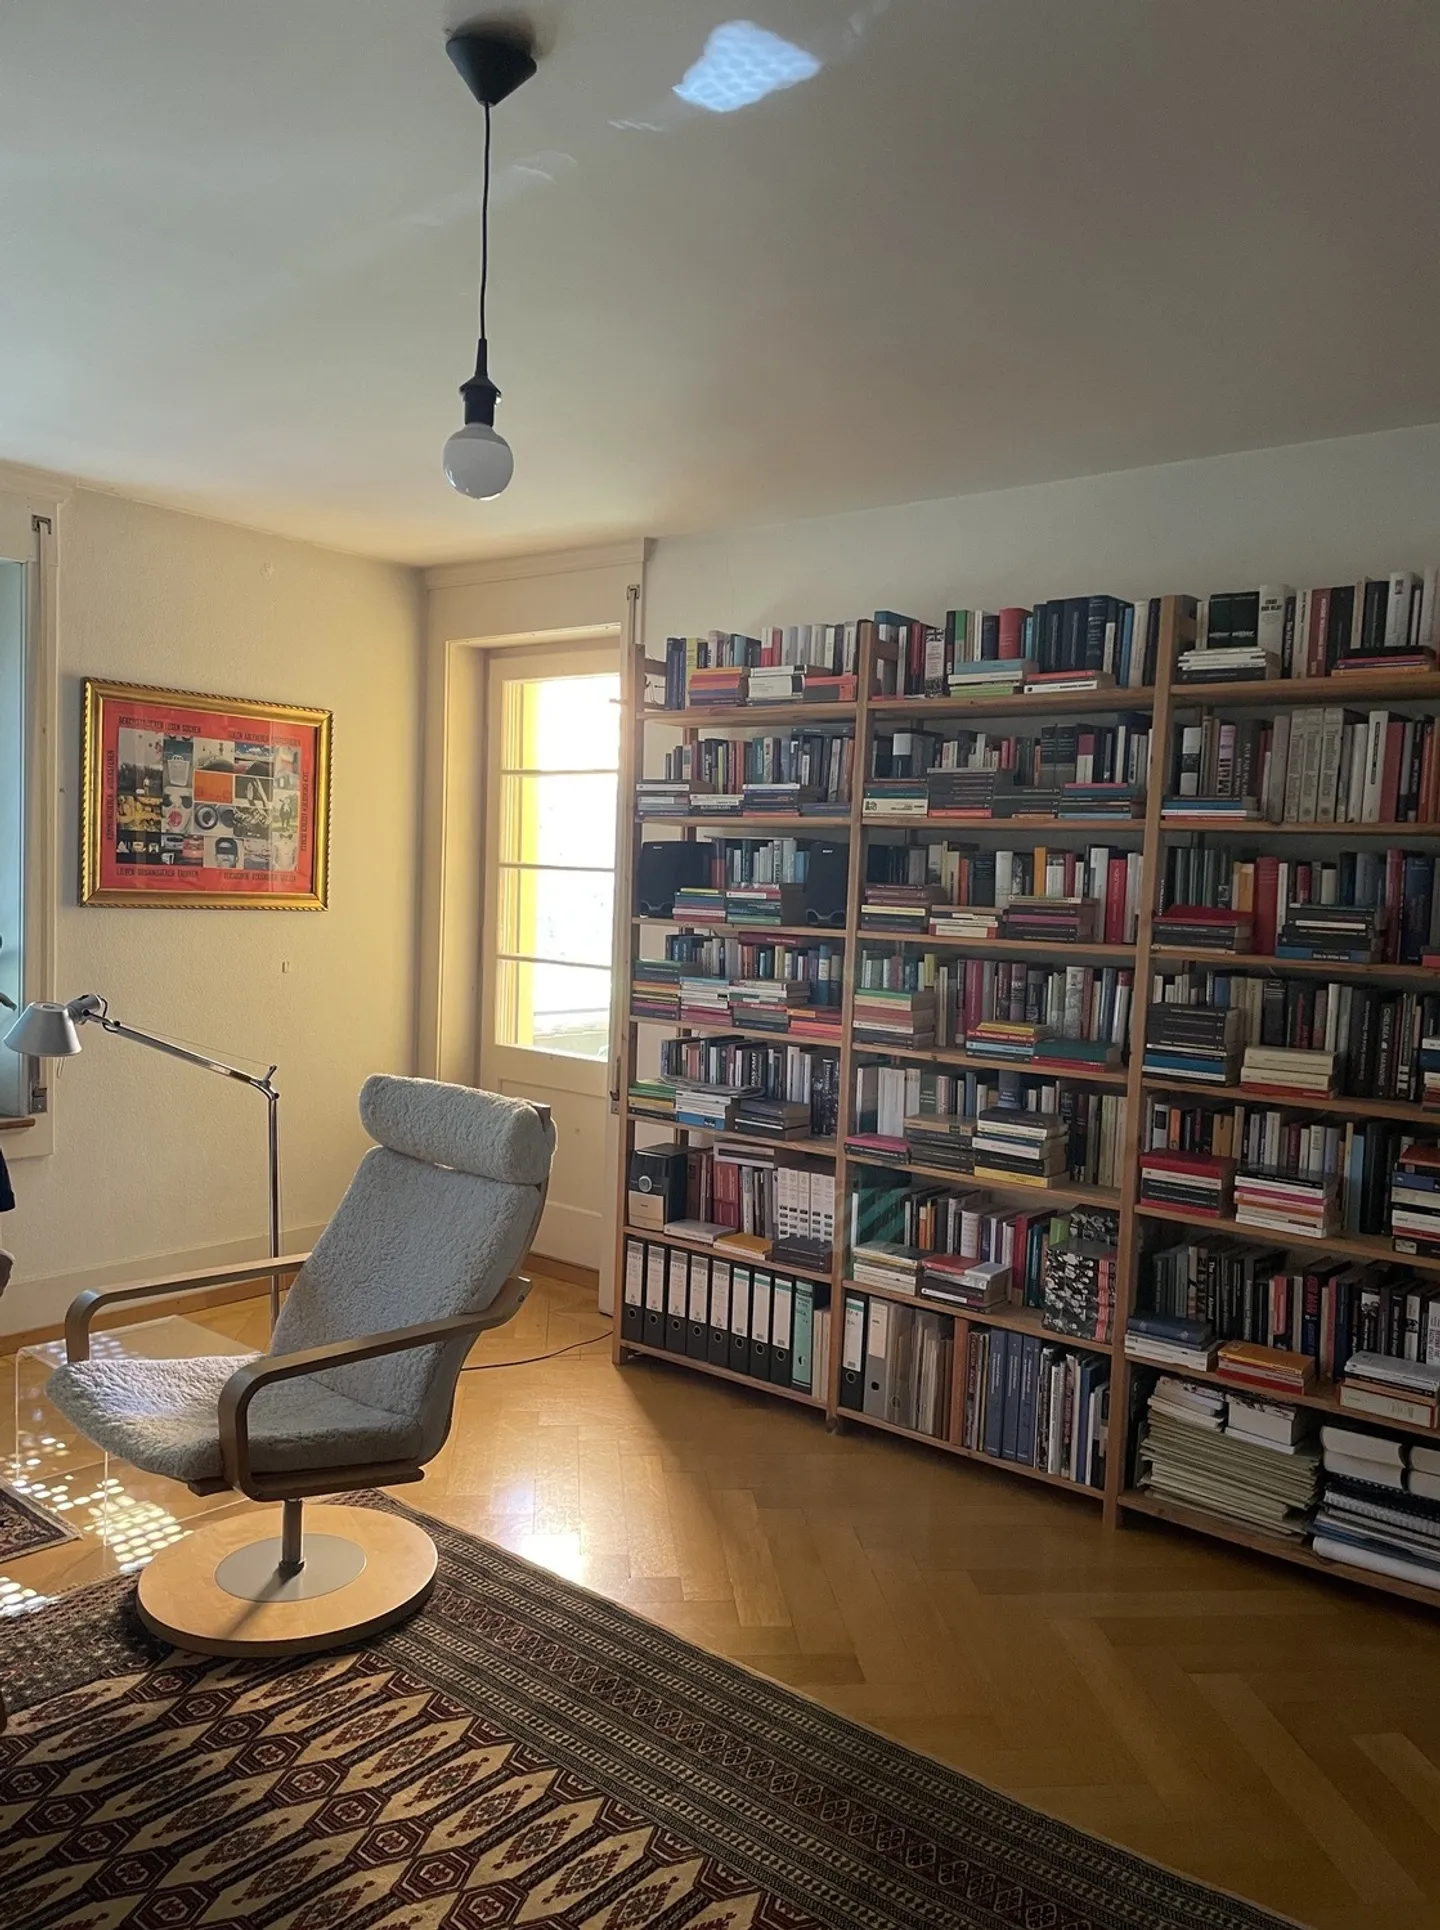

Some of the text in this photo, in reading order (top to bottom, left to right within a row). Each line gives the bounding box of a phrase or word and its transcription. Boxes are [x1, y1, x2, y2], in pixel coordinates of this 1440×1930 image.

[1218, 758, 1232, 794] Müll
[1378, 1008, 1391, 1086] CHELSEA MANNING
